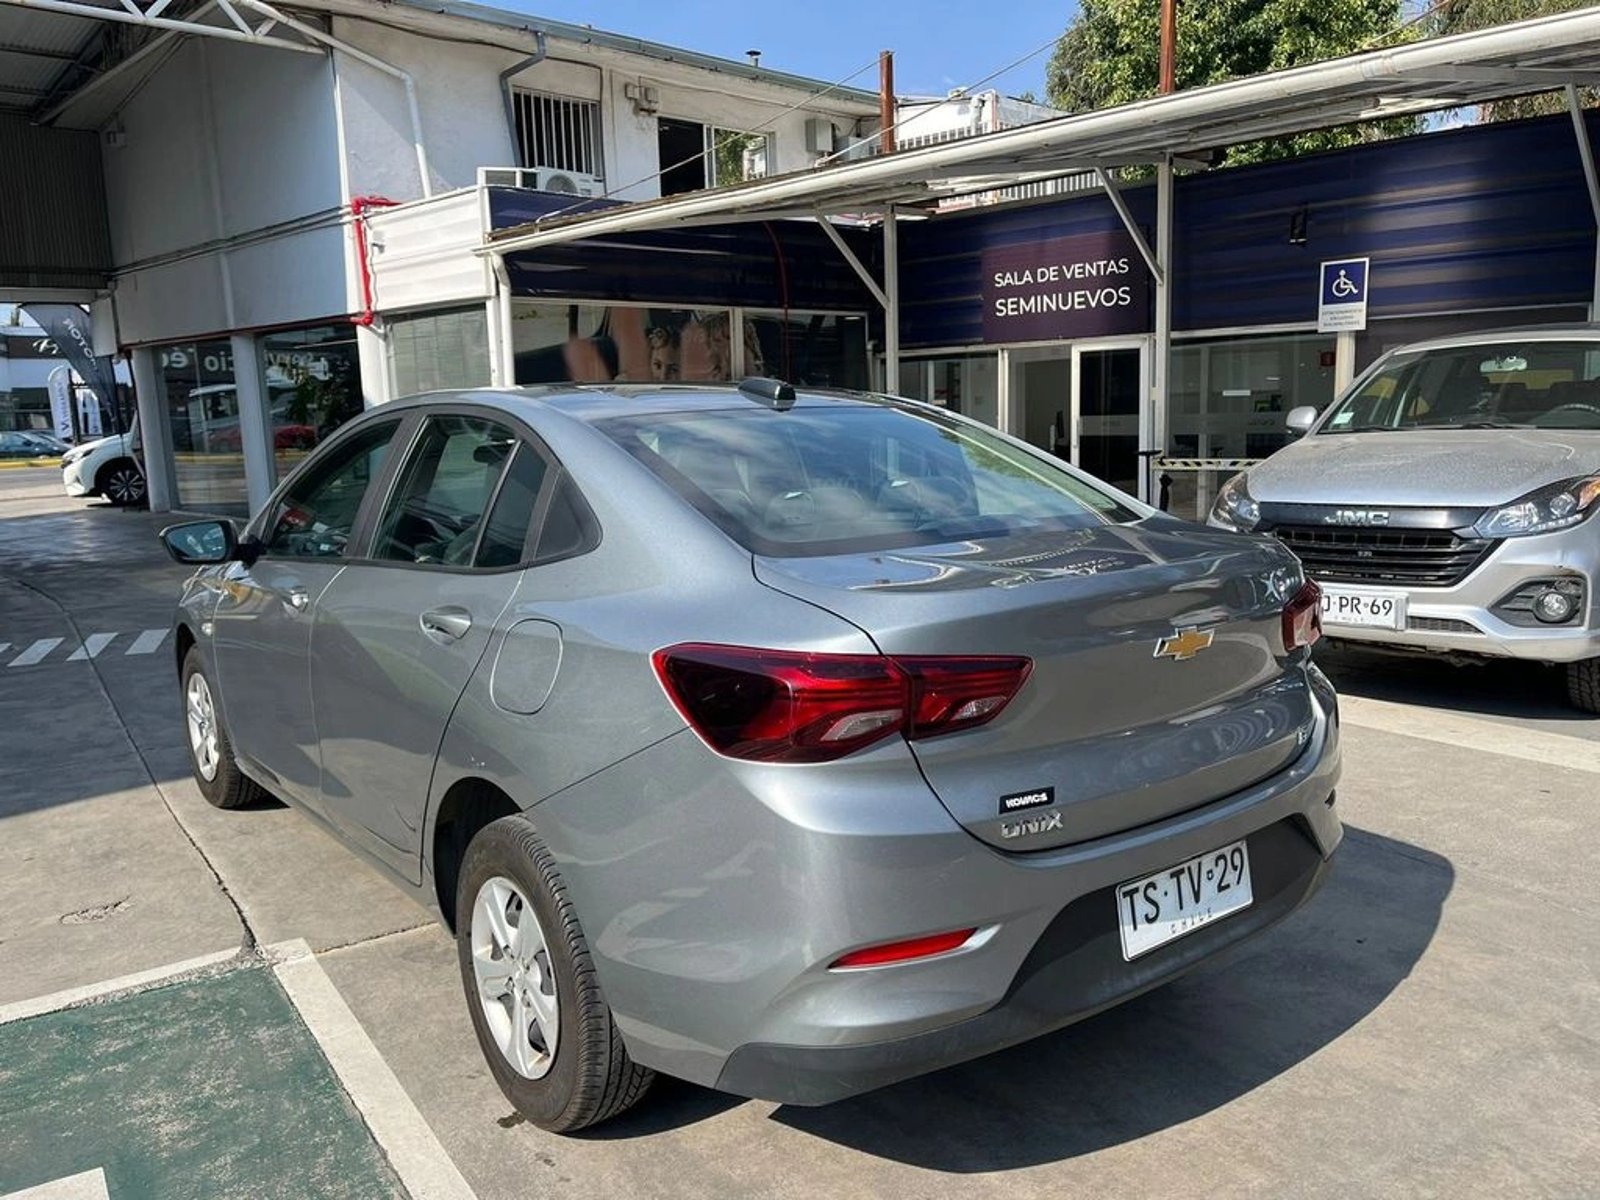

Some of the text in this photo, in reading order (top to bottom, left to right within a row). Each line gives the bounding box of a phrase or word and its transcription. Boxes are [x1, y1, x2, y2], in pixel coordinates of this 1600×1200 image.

[994, 258, 1129, 288] SALA DE VENTAS
[995, 286, 1131, 317] SEMINUEVOS
[1324, 509, 1390, 527] JMC
[1005, 792, 1048, 809] KOVACS
[1000, 811, 1064, 839] ONIX
